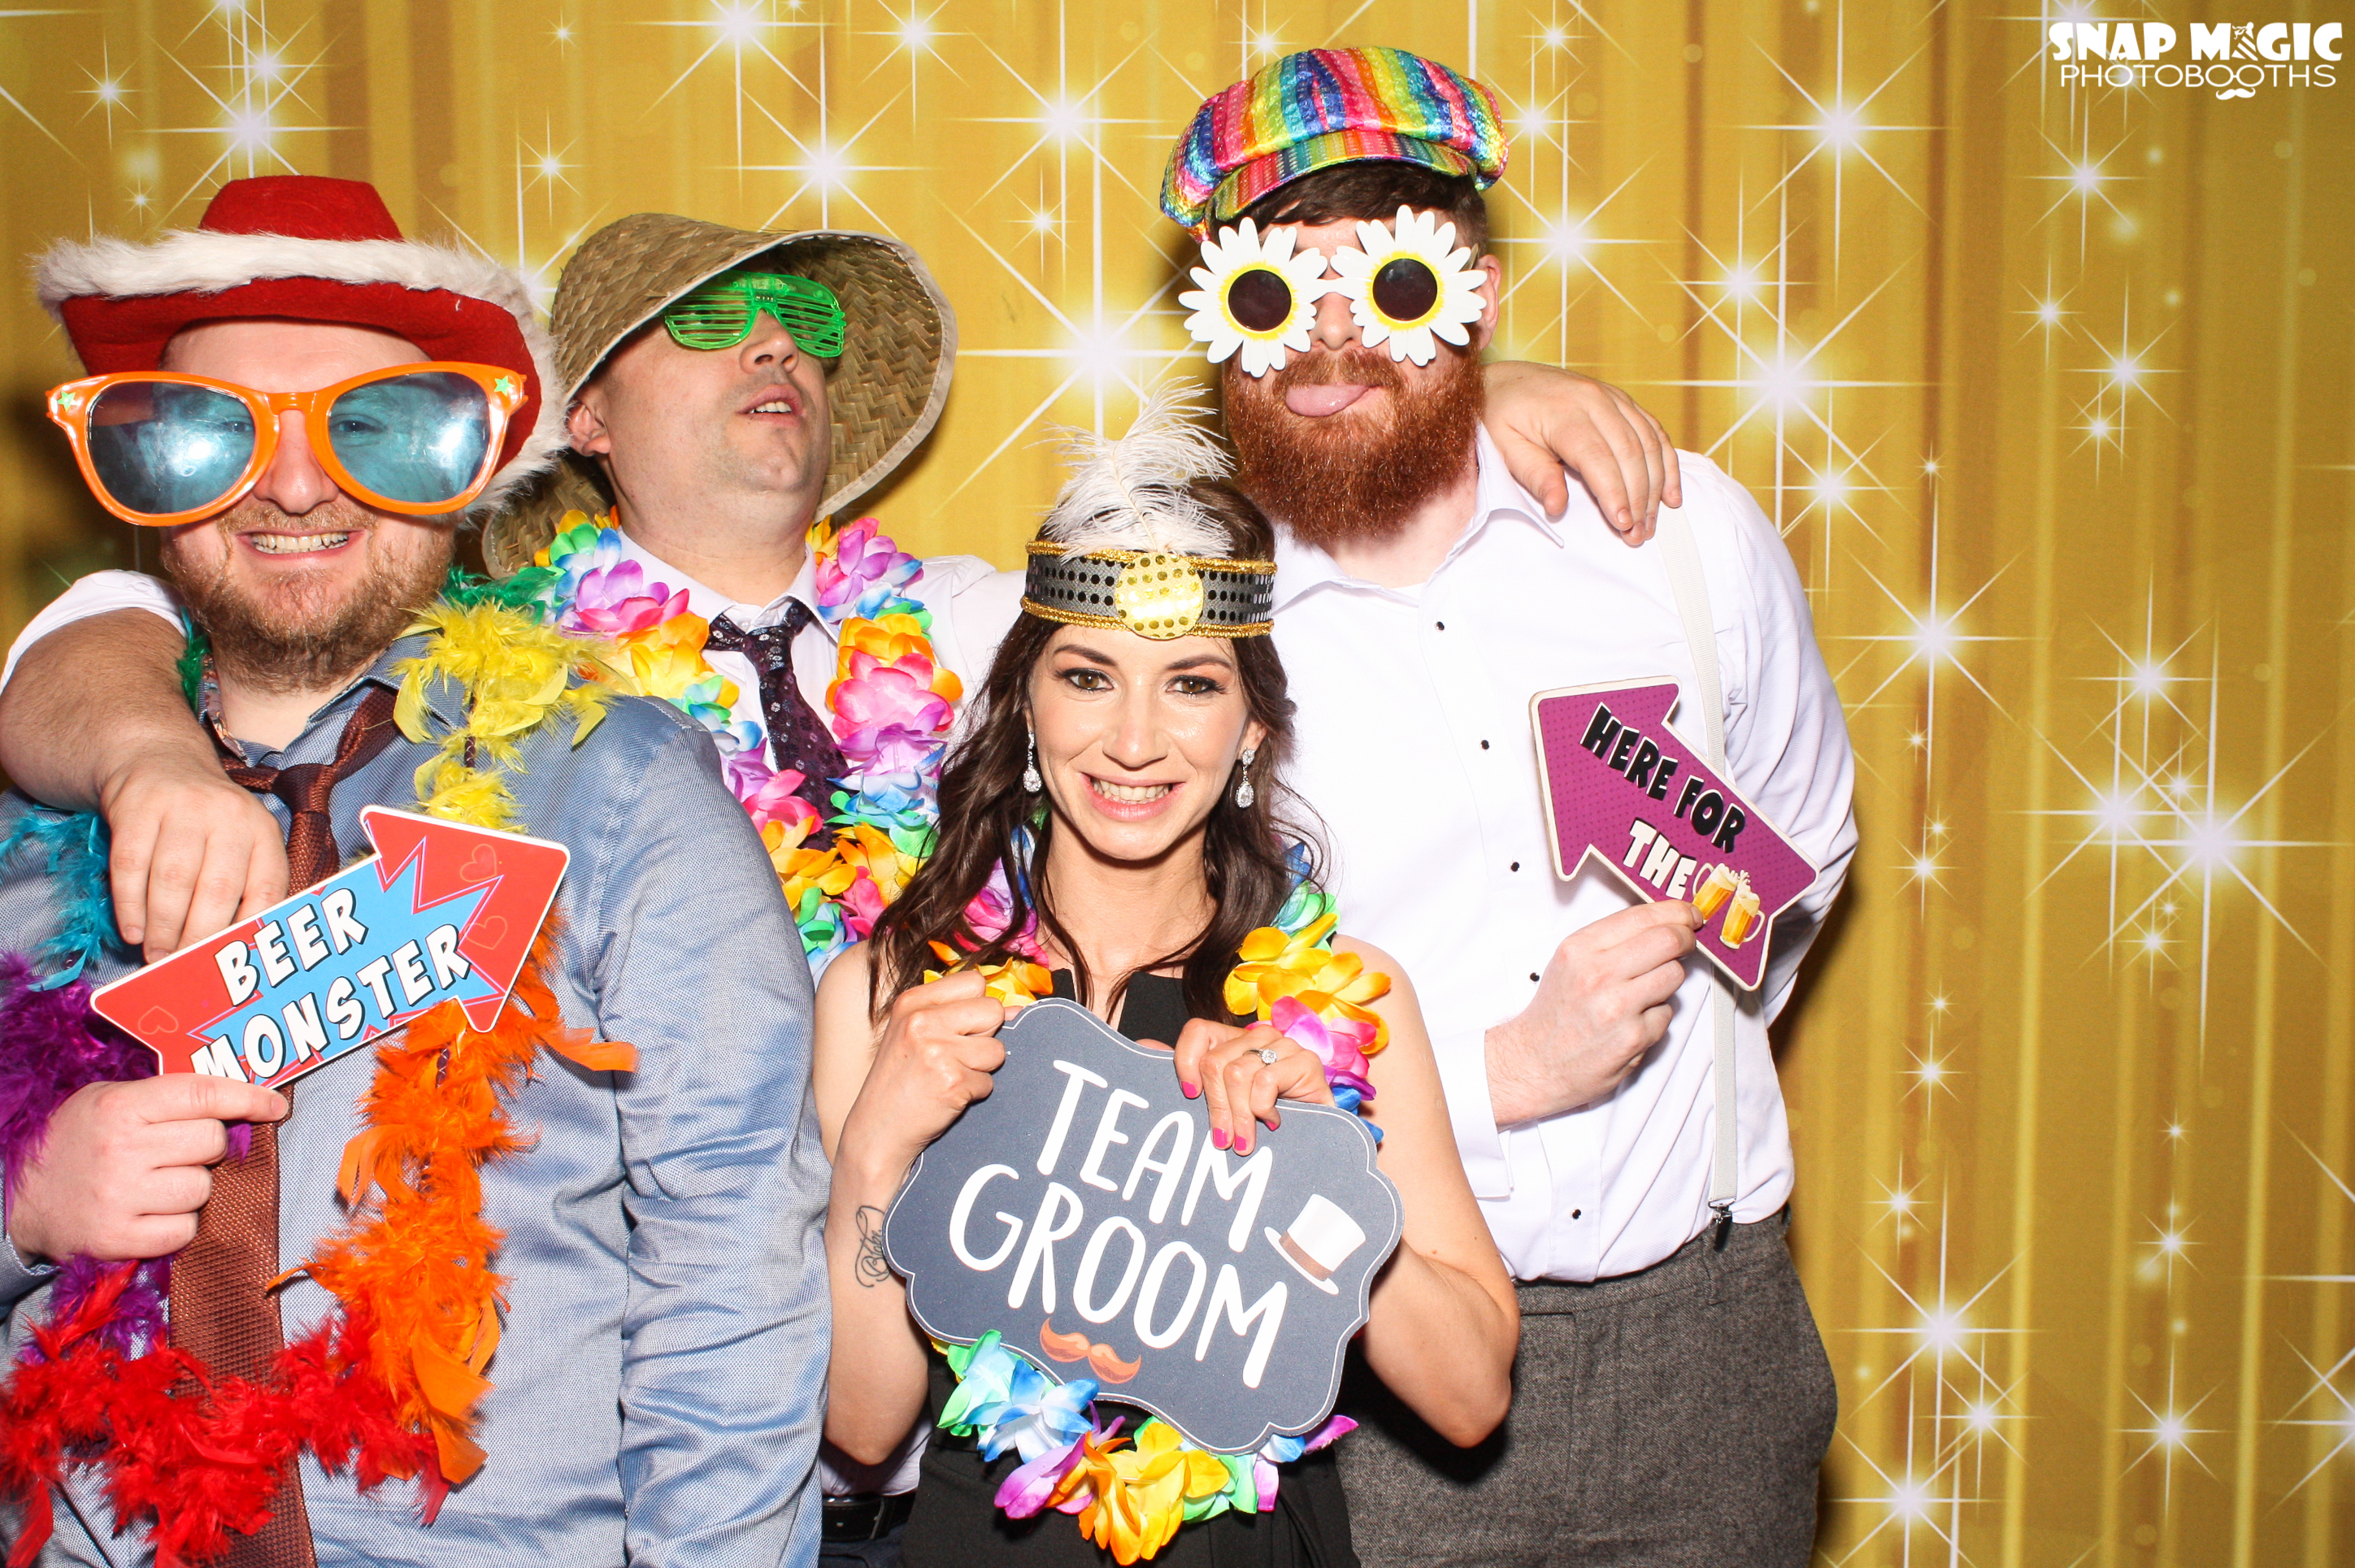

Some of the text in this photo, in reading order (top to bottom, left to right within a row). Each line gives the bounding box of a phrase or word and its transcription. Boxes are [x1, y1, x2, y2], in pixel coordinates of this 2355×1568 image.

[1579, 701, 1746, 853] HERE FOR
[1623, 817, 1697, 900] THE
[190, 923, 471, 1083] MONSTER
[214, 887, 369, 1007] BEER
[1036, 1060, 1273, 1253] TEAM
[949, 1163, 1288, 1388] GROOM
